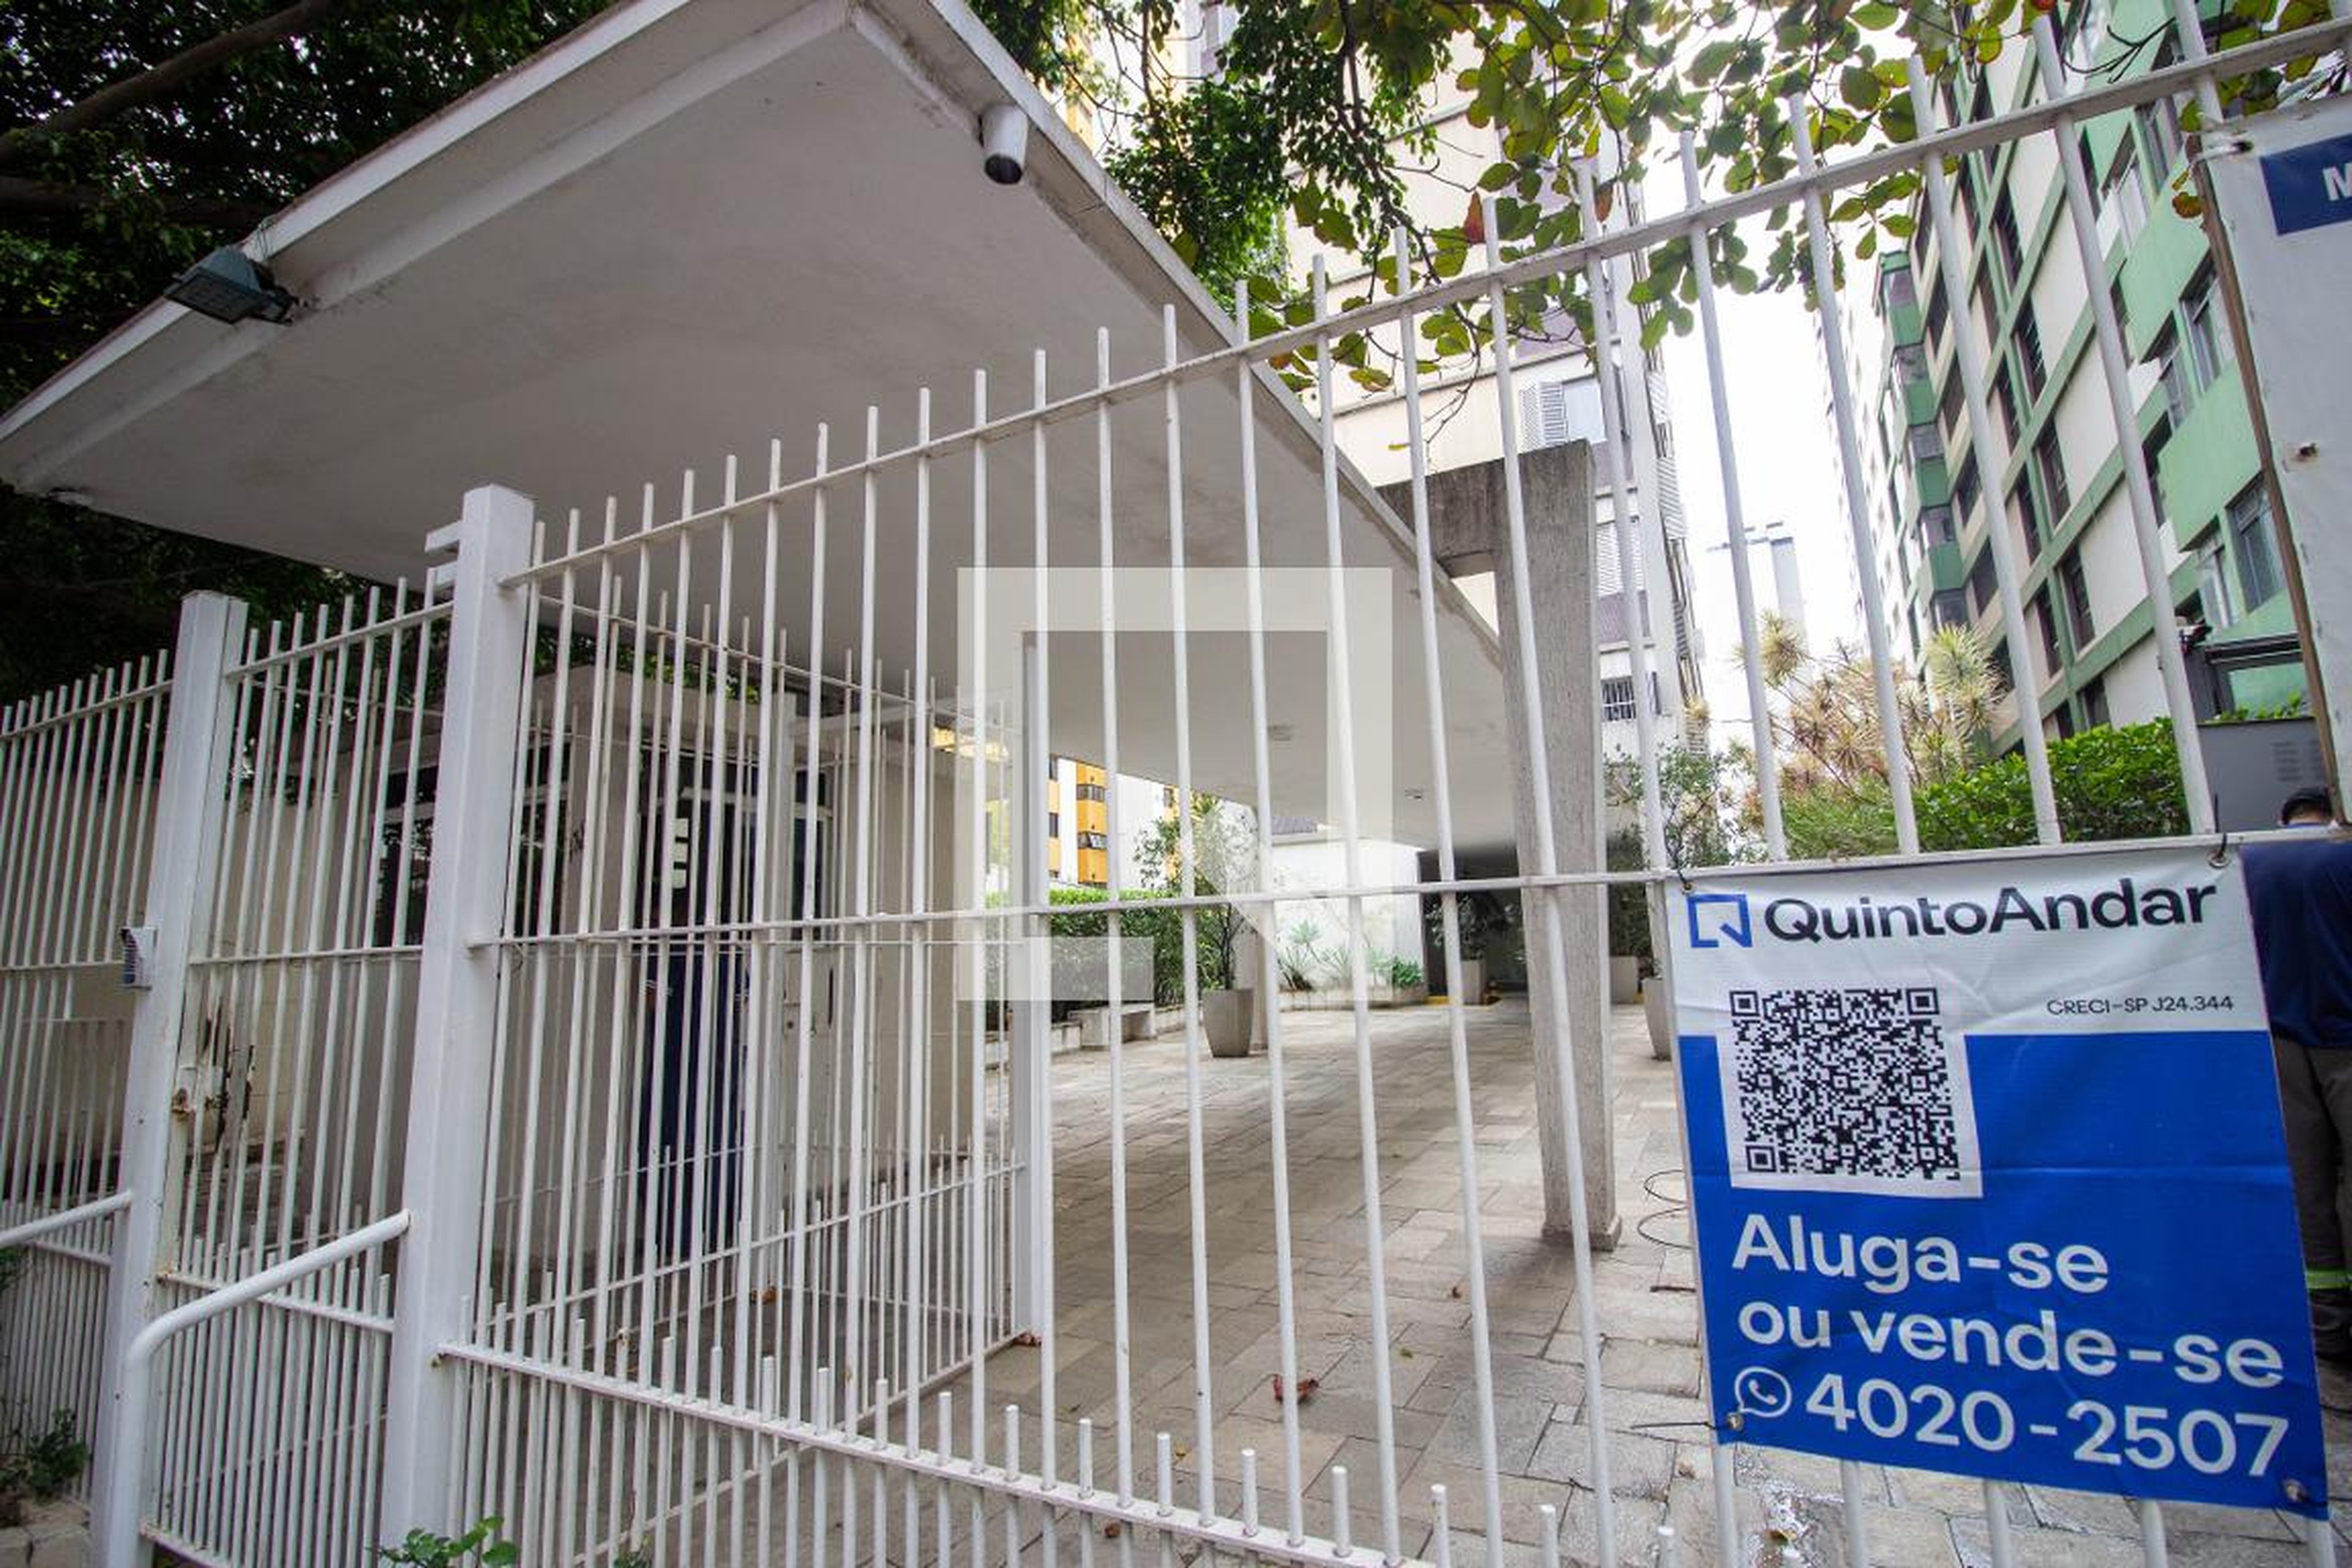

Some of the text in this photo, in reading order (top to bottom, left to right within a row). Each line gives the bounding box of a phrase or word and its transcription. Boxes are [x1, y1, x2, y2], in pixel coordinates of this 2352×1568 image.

[1764, 878, 2217, 943] QuintoAndar
[2046, 995, 2234, 1015] CRECI-SP J24.344
[1732, 1213, 2109, 1294] Aluga-se
[1738, 1301, 2284, 1388] ou vende-se
